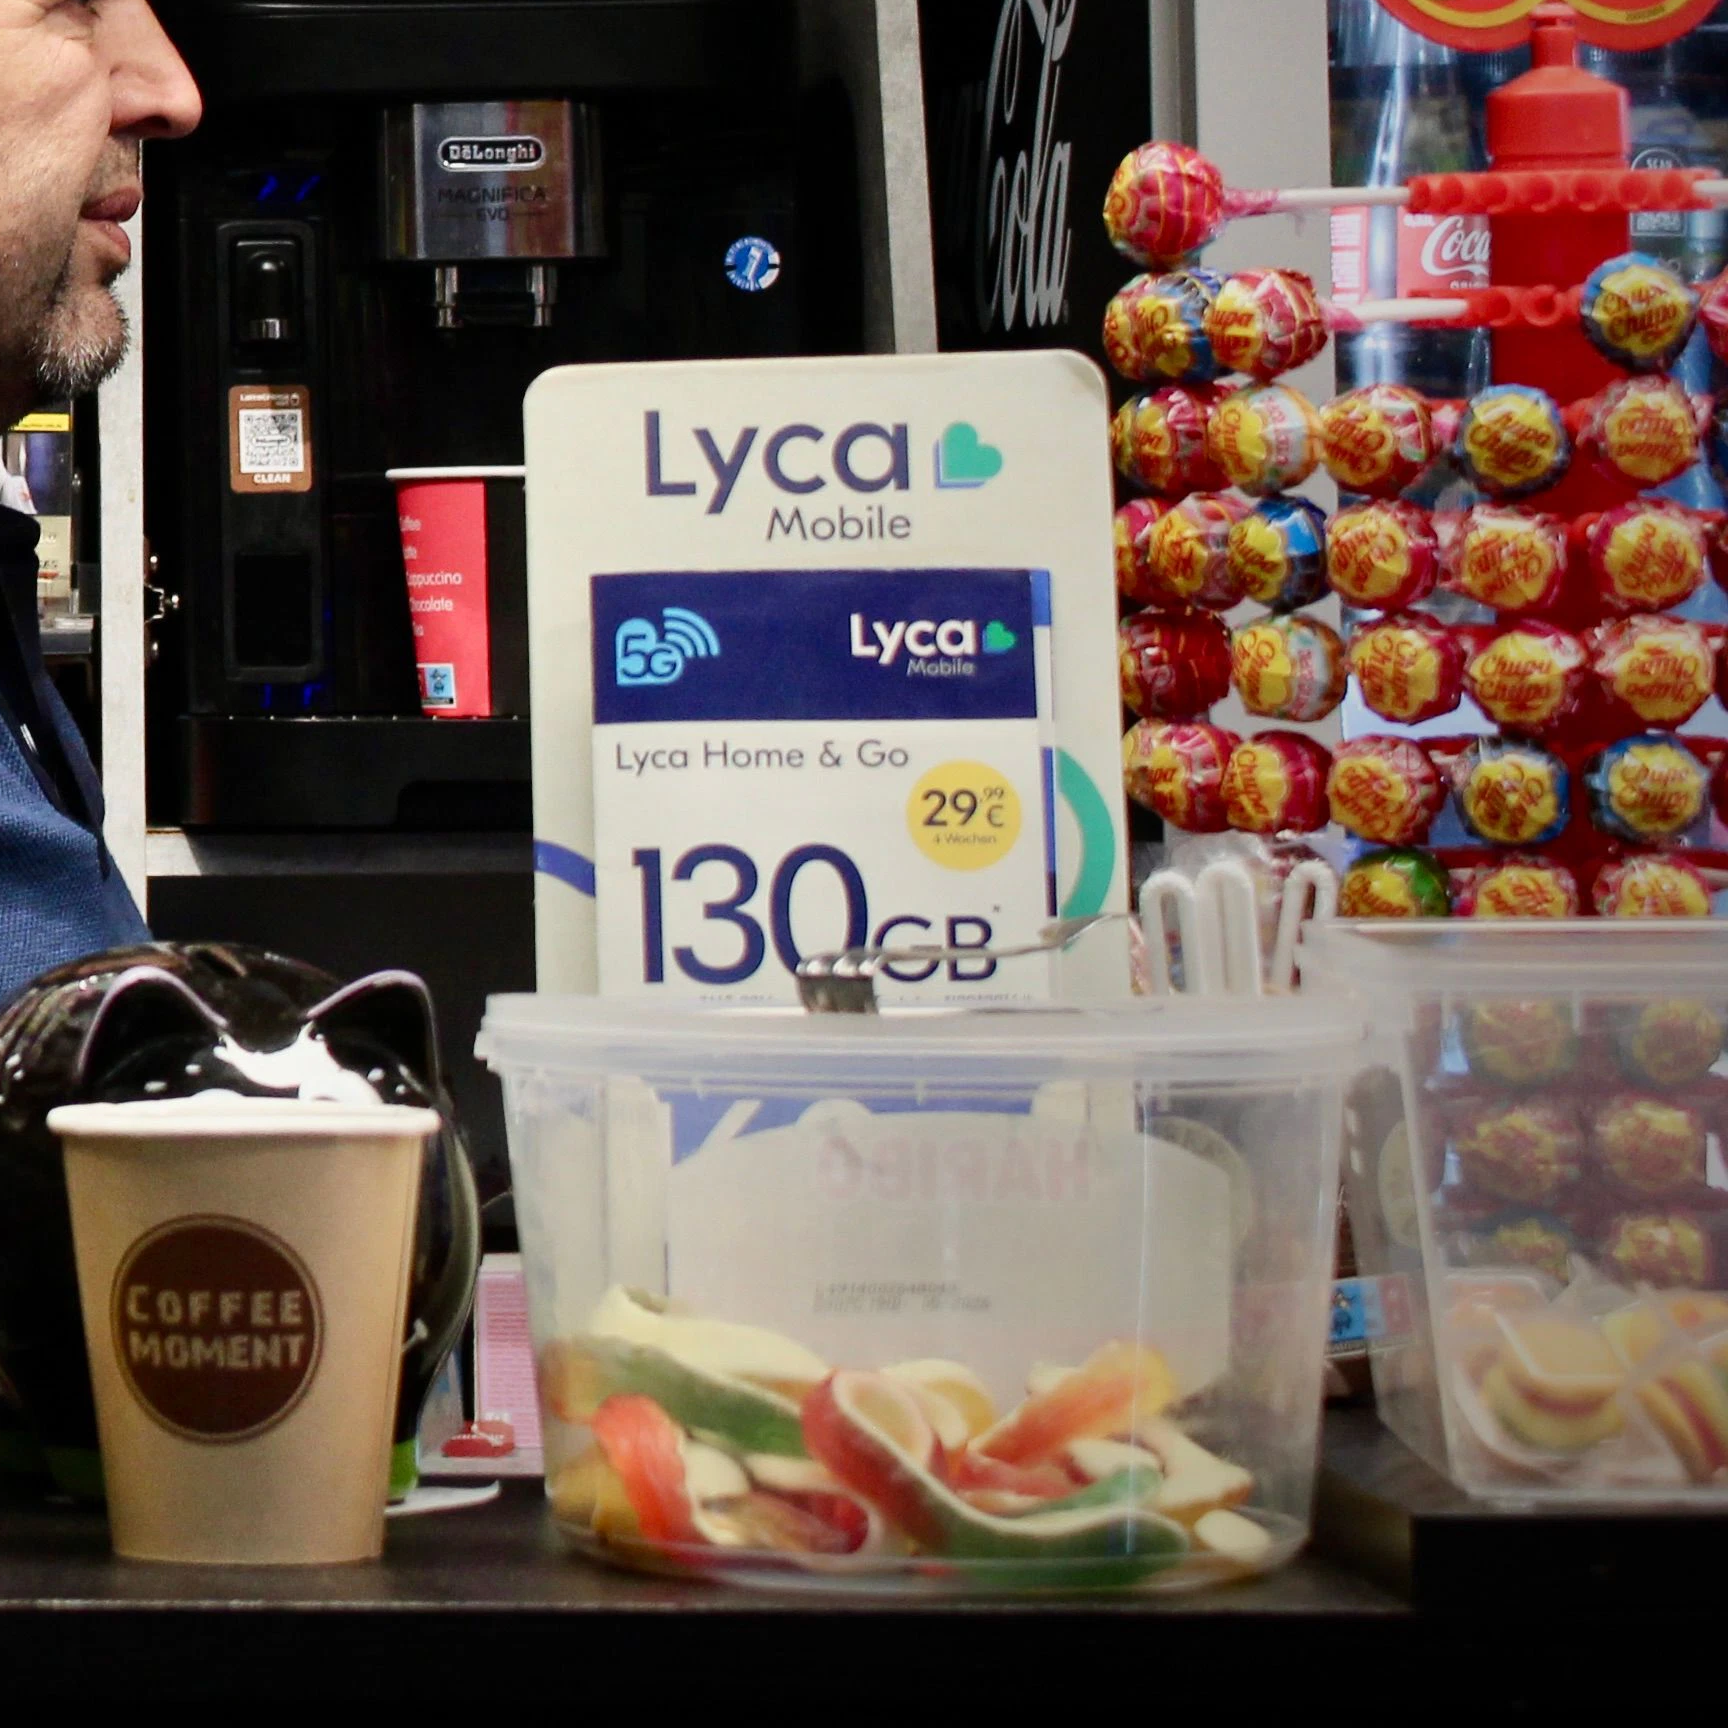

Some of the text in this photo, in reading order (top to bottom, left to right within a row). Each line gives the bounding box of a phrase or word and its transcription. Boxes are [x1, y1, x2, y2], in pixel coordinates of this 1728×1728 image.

[1421, 214, 1491, 274] Coca
[253, 473, 291, 484] CLEAN
[645, 410, 910, 515] Lyca
[766, 507, 911, 541] Mobile
[850, 613, 974, 665] Lyca
[907, 658, 976, 677] Mobile
[616, 740, 909, 774] Lyca Home & Go
[631, 843, 868, 984] 130
[126, 1285, 303, 1325] COFFEE
[128, 1331, 306, 1371] MOMENT
